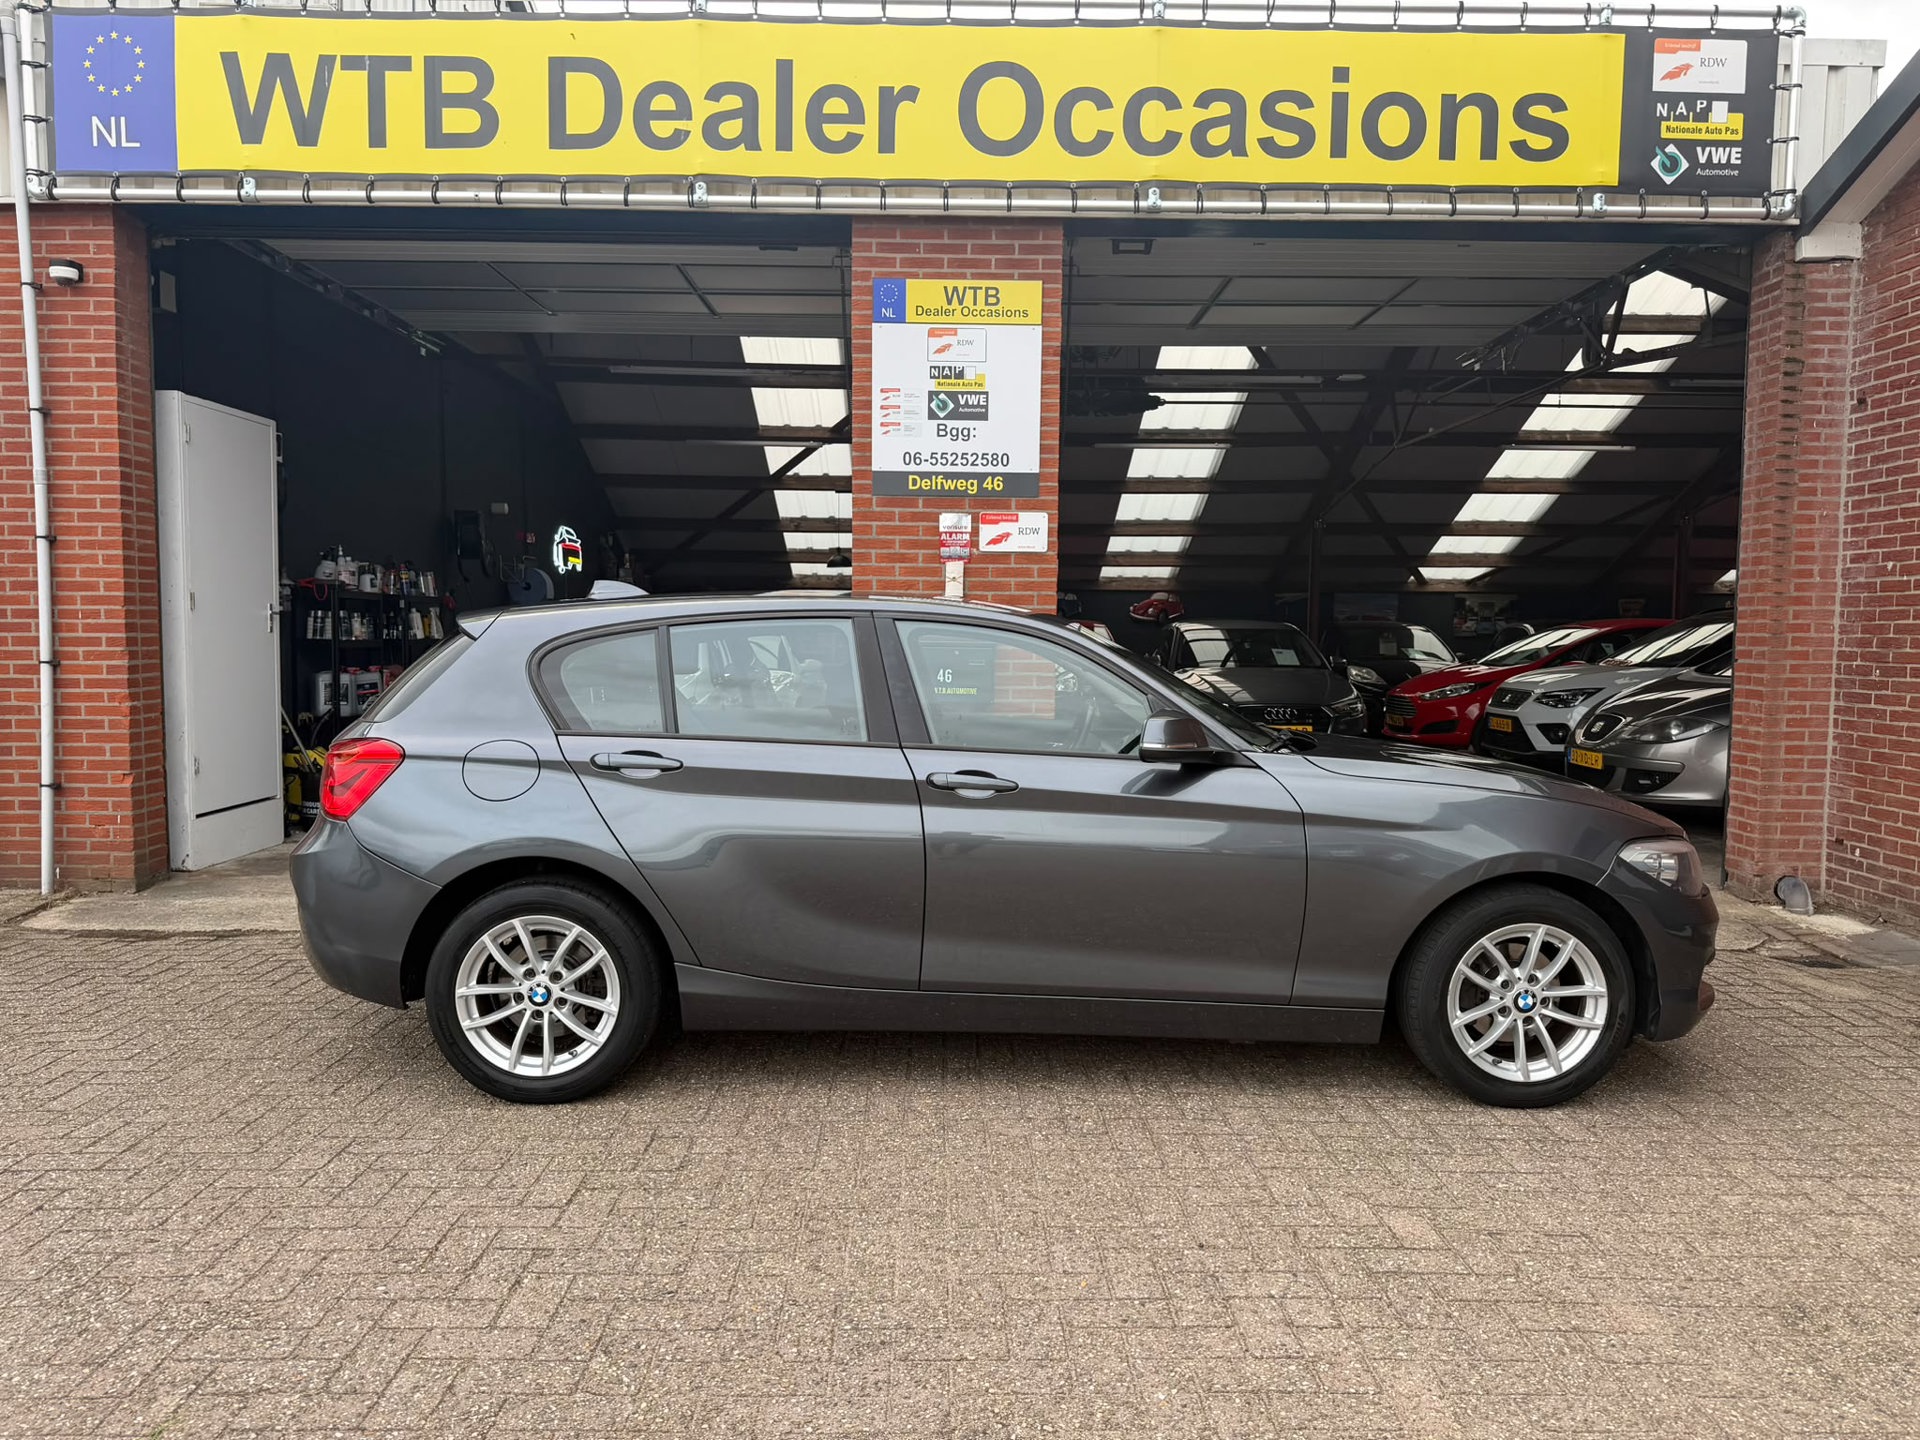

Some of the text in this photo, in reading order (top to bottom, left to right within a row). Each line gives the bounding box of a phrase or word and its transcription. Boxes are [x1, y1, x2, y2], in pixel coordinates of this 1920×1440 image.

[1699, 57, 1728, 68] RDW
[219, 51, 1570, 163] WTB Dealer Occasions
[91, 115, 141, 148] NL
[1665, 124, 1740, 136] Nationale Auto Pas
[1696, 146, 1742, 165] VWE
[1696, 168, 1740, 177] Automotive
[943, 285, 1001, 307] WTB
[881, 308, 897, 318] NL
[915, 305, 1029, 318] Dealer Occasions
[956, 339, 975, 347] RDW
[957, 394, 987, 406] VWE
[936, 423, 977, 441] Bgg:
[902, 451, 1010, 467] 06-55252580
[908, 475, 1004, 494] Delfweg 46
[940, 533, 970, 541] ALARM
[1017, 527, 1041, 536] RDW
[937, 668, 953, 683] 46
